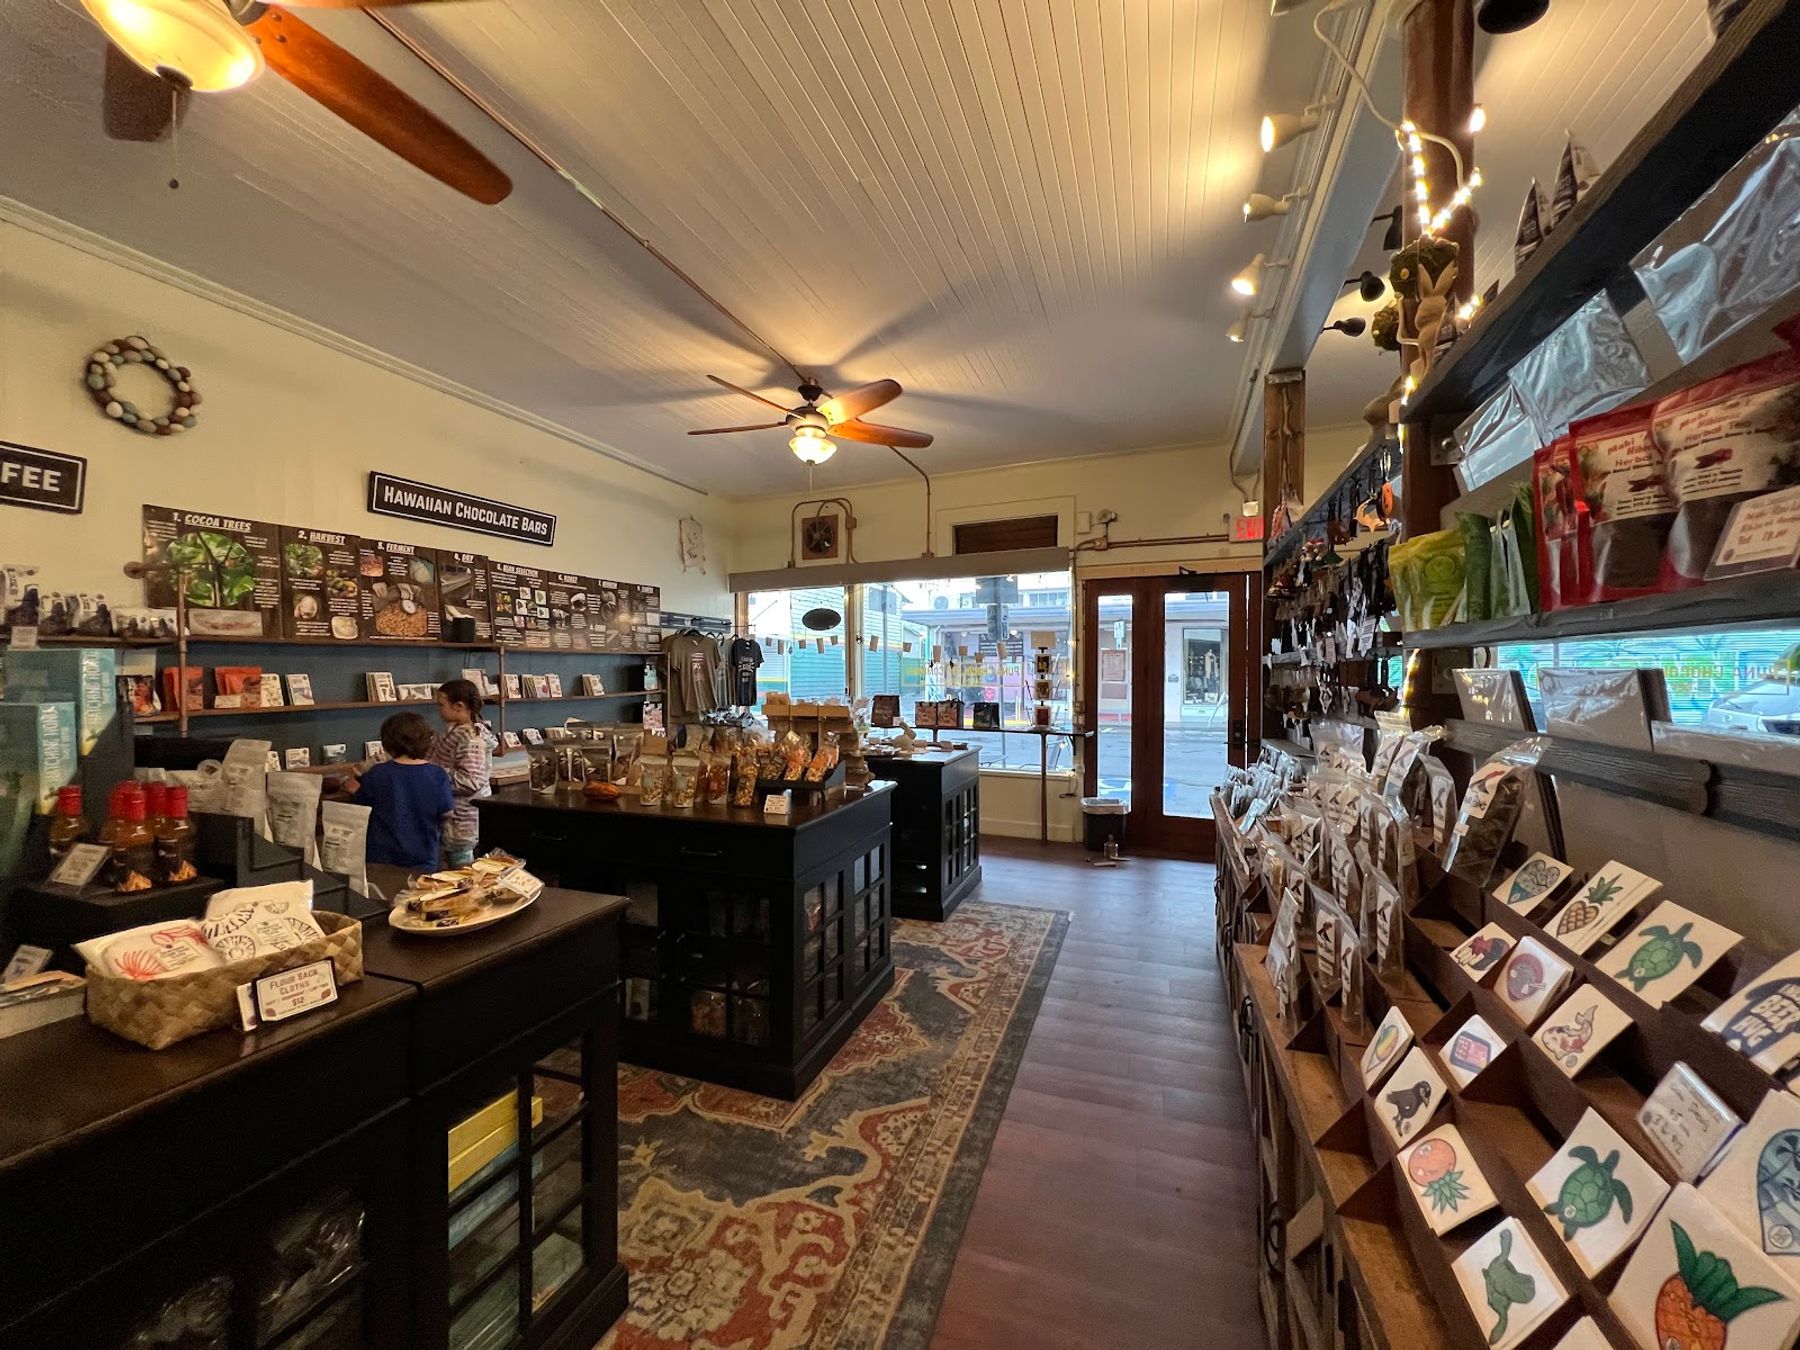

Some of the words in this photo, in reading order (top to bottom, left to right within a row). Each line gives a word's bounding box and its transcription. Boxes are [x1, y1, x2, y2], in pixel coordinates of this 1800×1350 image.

[384, 485, 451, 515] HAWAIIAN
[455, 501, 519, 529] CHOCOLATE
[521, 516, 548, 536] BARS
[184, 514, 220, 527] COCOA
[223, 519, 252, 533] TREES
[309, 531, 346, 545] HARVEST
[269, 975, 296, 990] FLOUR
[297, 968, 318, 981] SACK
[280, 980, 310, 995] CLOTHS
